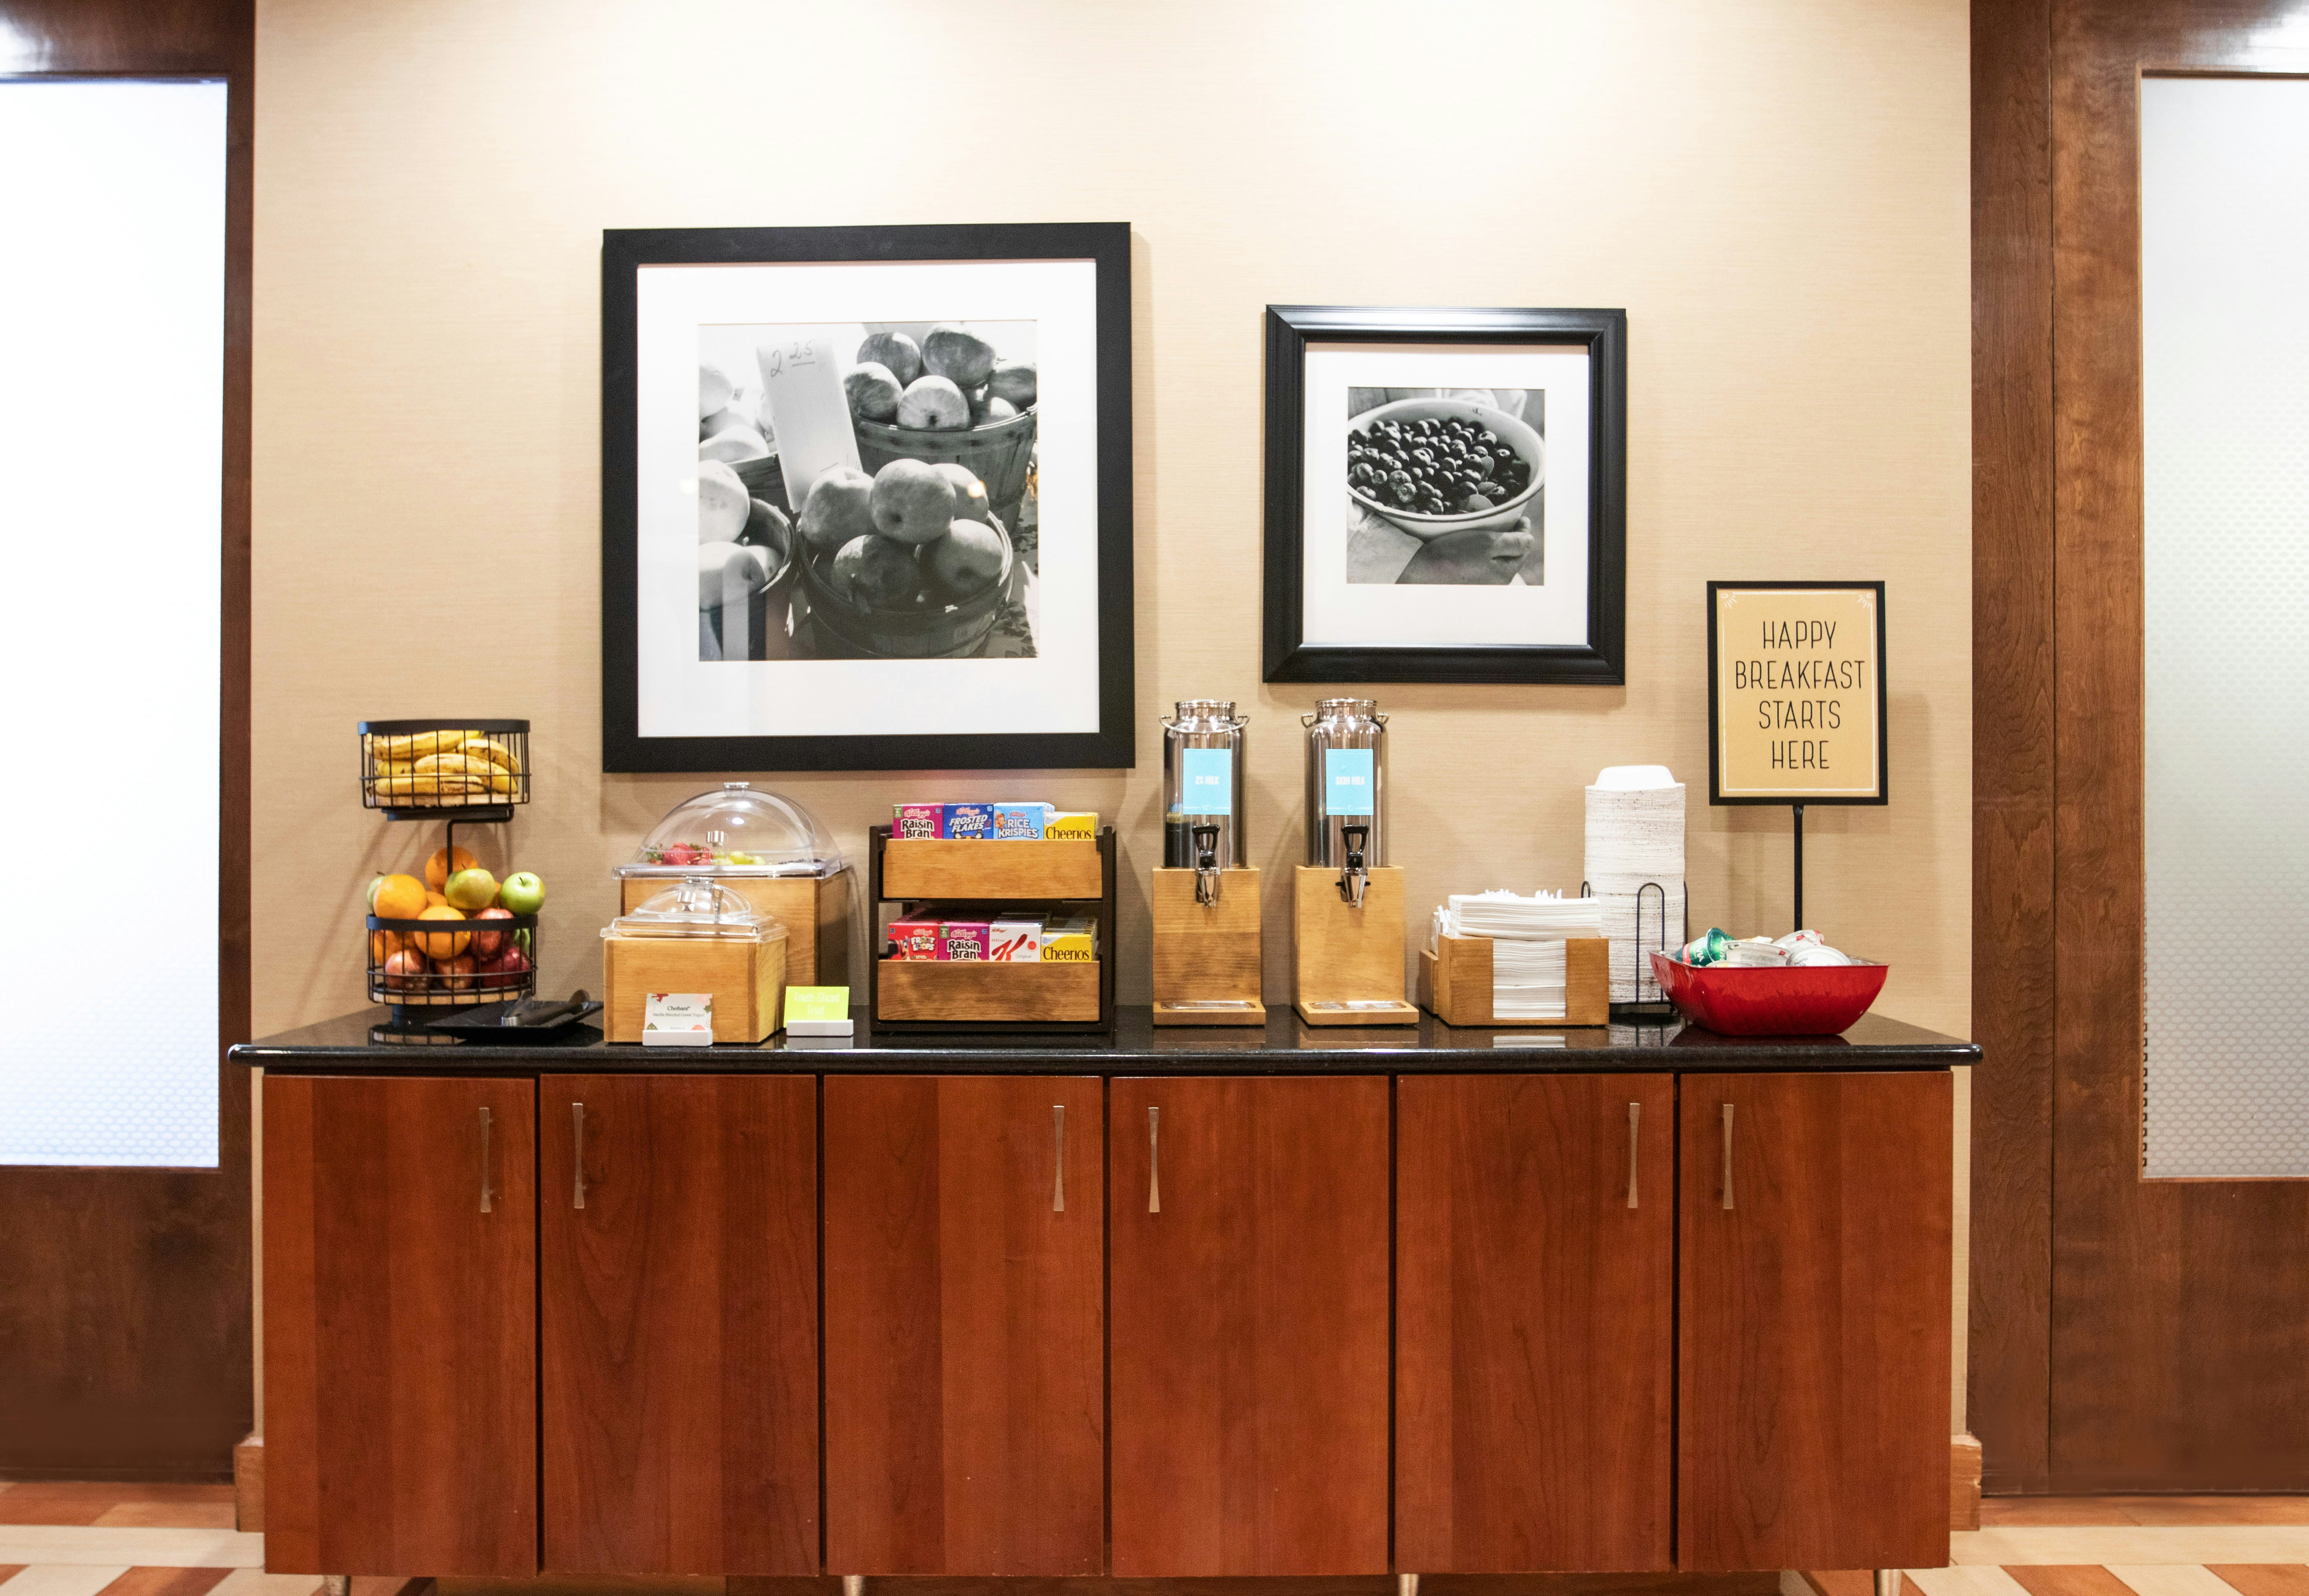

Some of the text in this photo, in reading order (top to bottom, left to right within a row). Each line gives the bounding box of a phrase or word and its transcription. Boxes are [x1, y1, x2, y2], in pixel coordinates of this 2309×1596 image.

[1763, 621, 1836, 649] HAPPY
[1735, 660, 1865, 689] BREAKFAST
[1759, 700, 1840, 729] STARTS
[1772, 741, 1830, 769] HERE
[1351, 776, 1365, 785] MILK
[904, 808, 930, 819] Kellogg's
[902, 819, 934, 830] Raisin
[949, 815, 988, 826] FROSTED
[1007, 818, 1030, 828] RICE
[951, 822, 984, 833] FLAKES
[998, 827, 1039, 839] KRISPIES
[1046, 826, 1091, 839] Cheerios
[906, 829, 930, 839] Bran
[951, 929, 977, 939] Kellogg's
[948, 940, 980, 952] Raisin
[952, 950, 976, 960] Bran
[1043, 946, 1089, 960] Cheerios
